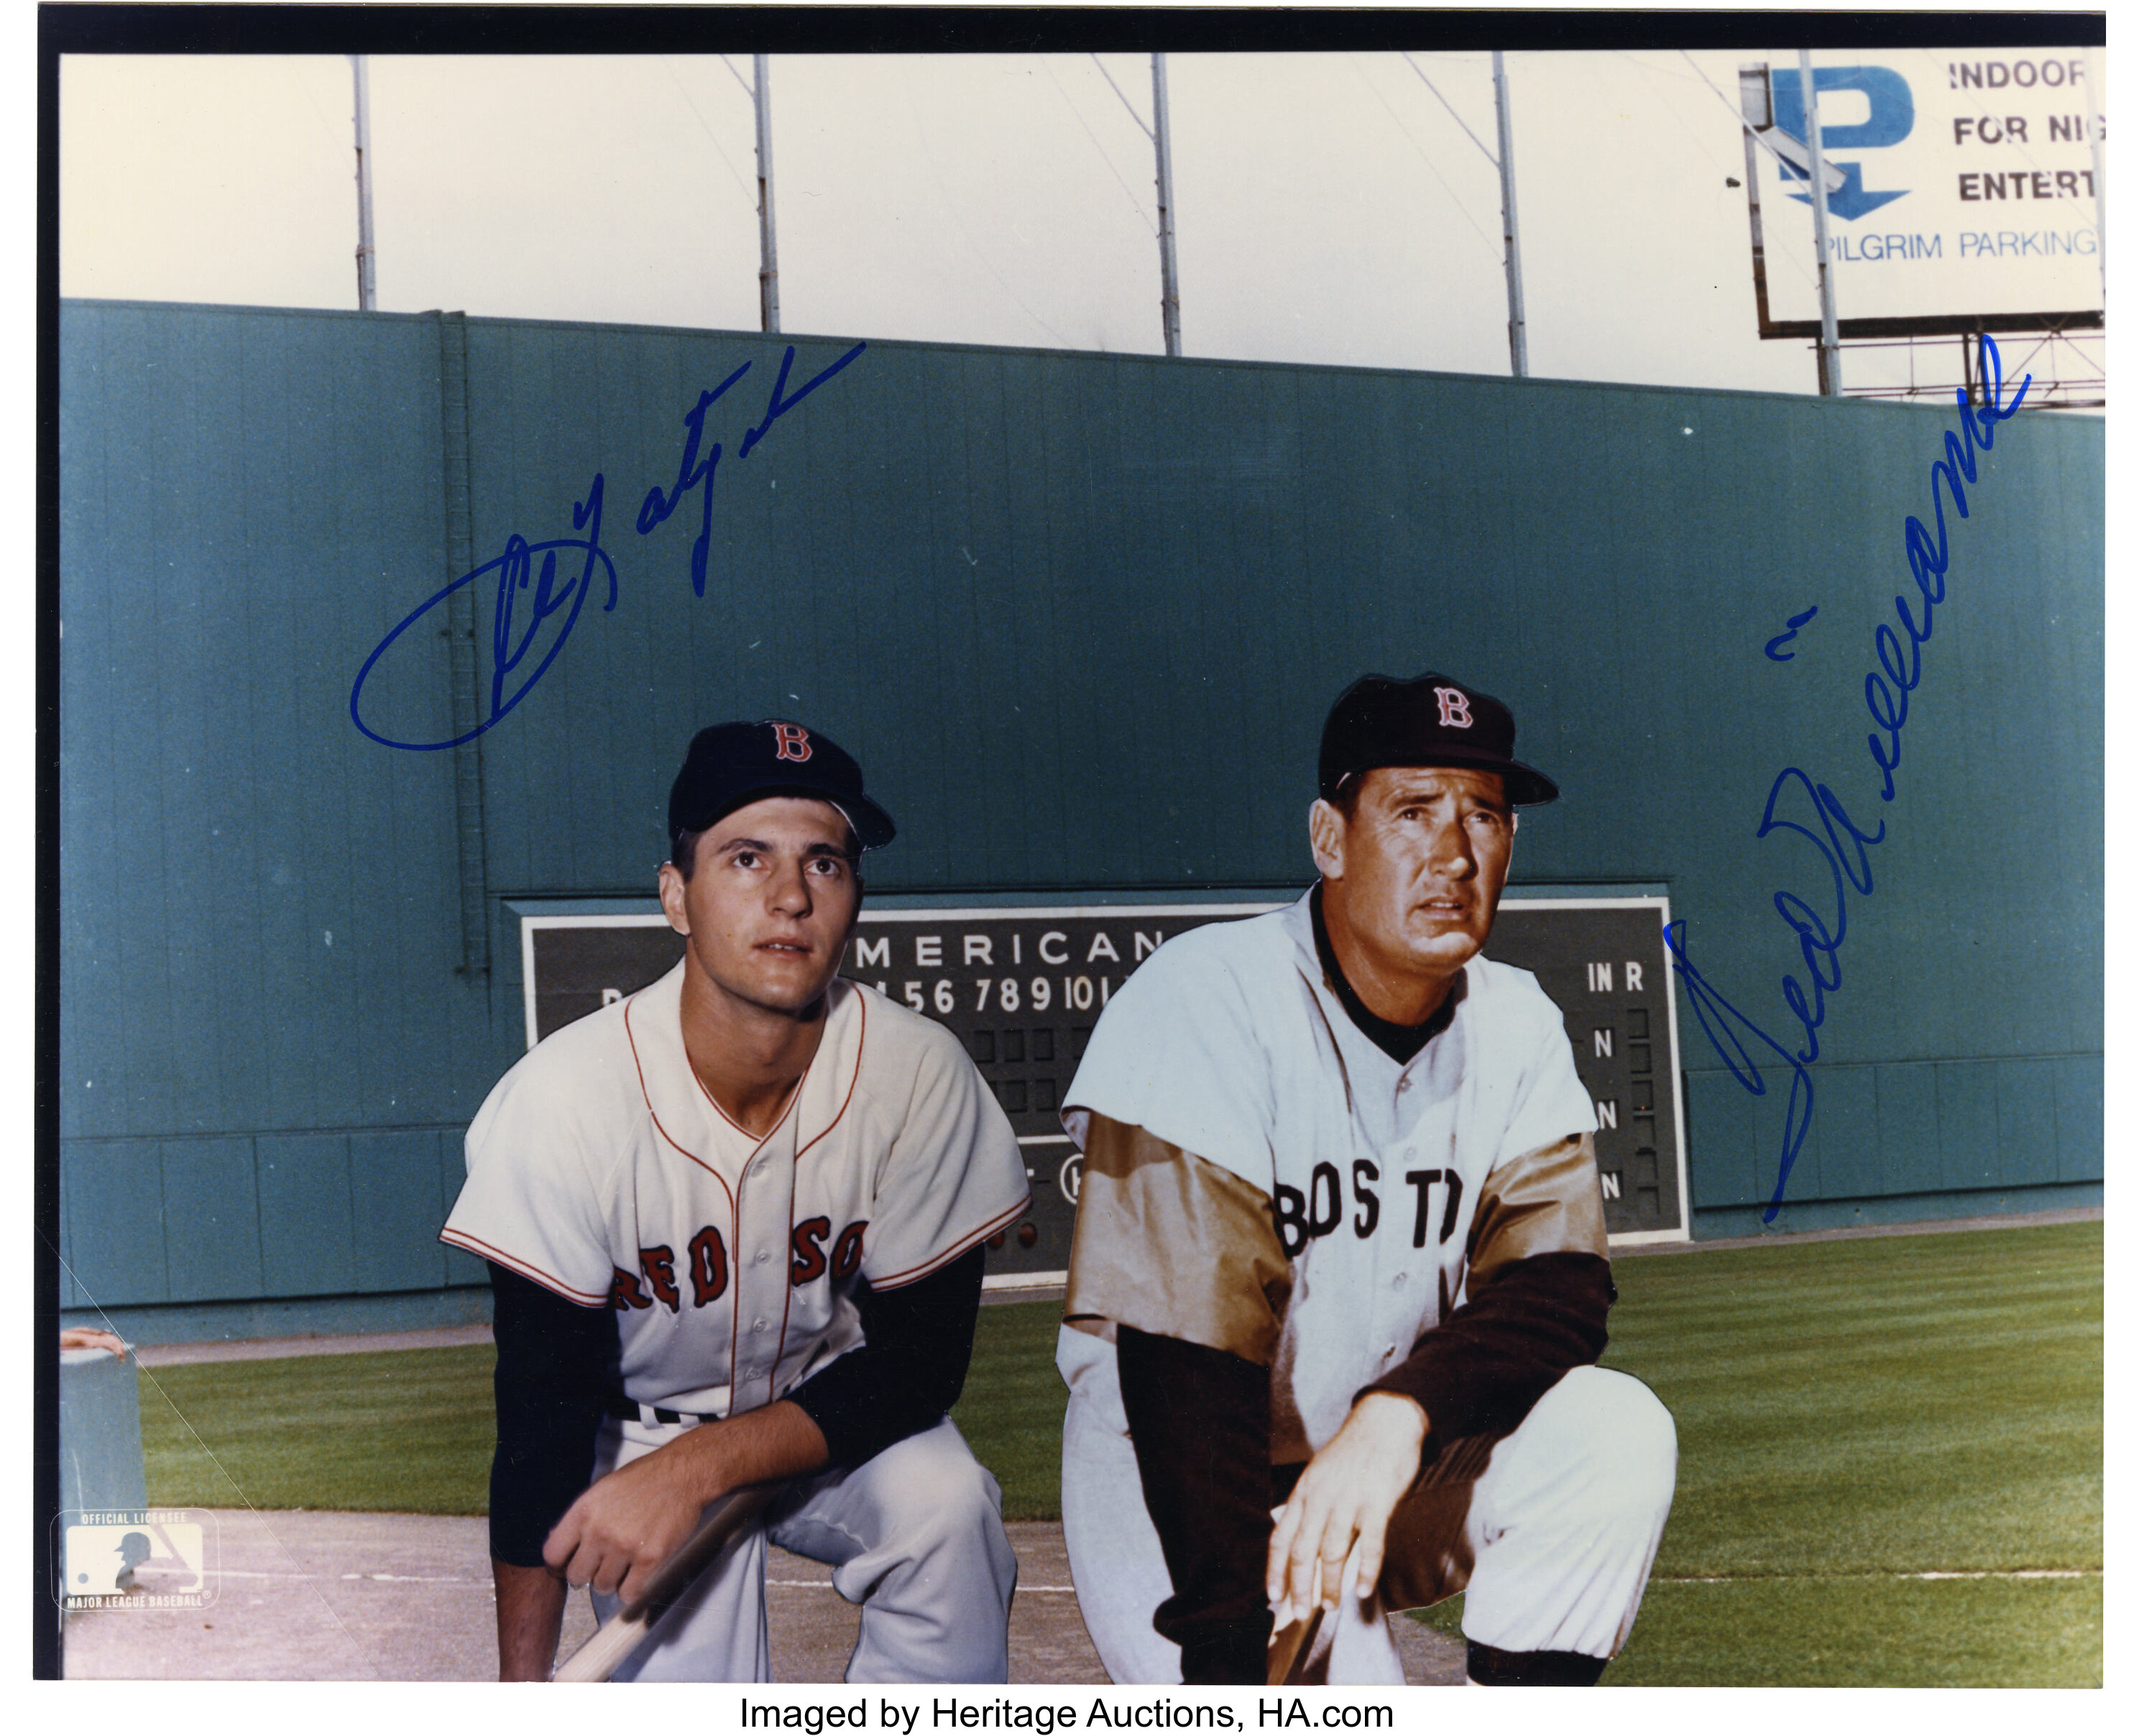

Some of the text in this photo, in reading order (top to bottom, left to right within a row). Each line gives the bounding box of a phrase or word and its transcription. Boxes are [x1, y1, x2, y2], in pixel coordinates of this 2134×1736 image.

[1954, 116, 2028, 145] FOR
[1959, 229, 2097, 258] PARKING
[1433, 687, 1473, 728] B
[771, 723, 813, 762] B
[1588, 961, 1643, 992] IN R
[1594, 1029, 1612, 1058] N
[1598, 1101, 1617, 1129] N
[1601, 1172, 1621, 1199] N
[612, 1225, 728, 1313] RED
